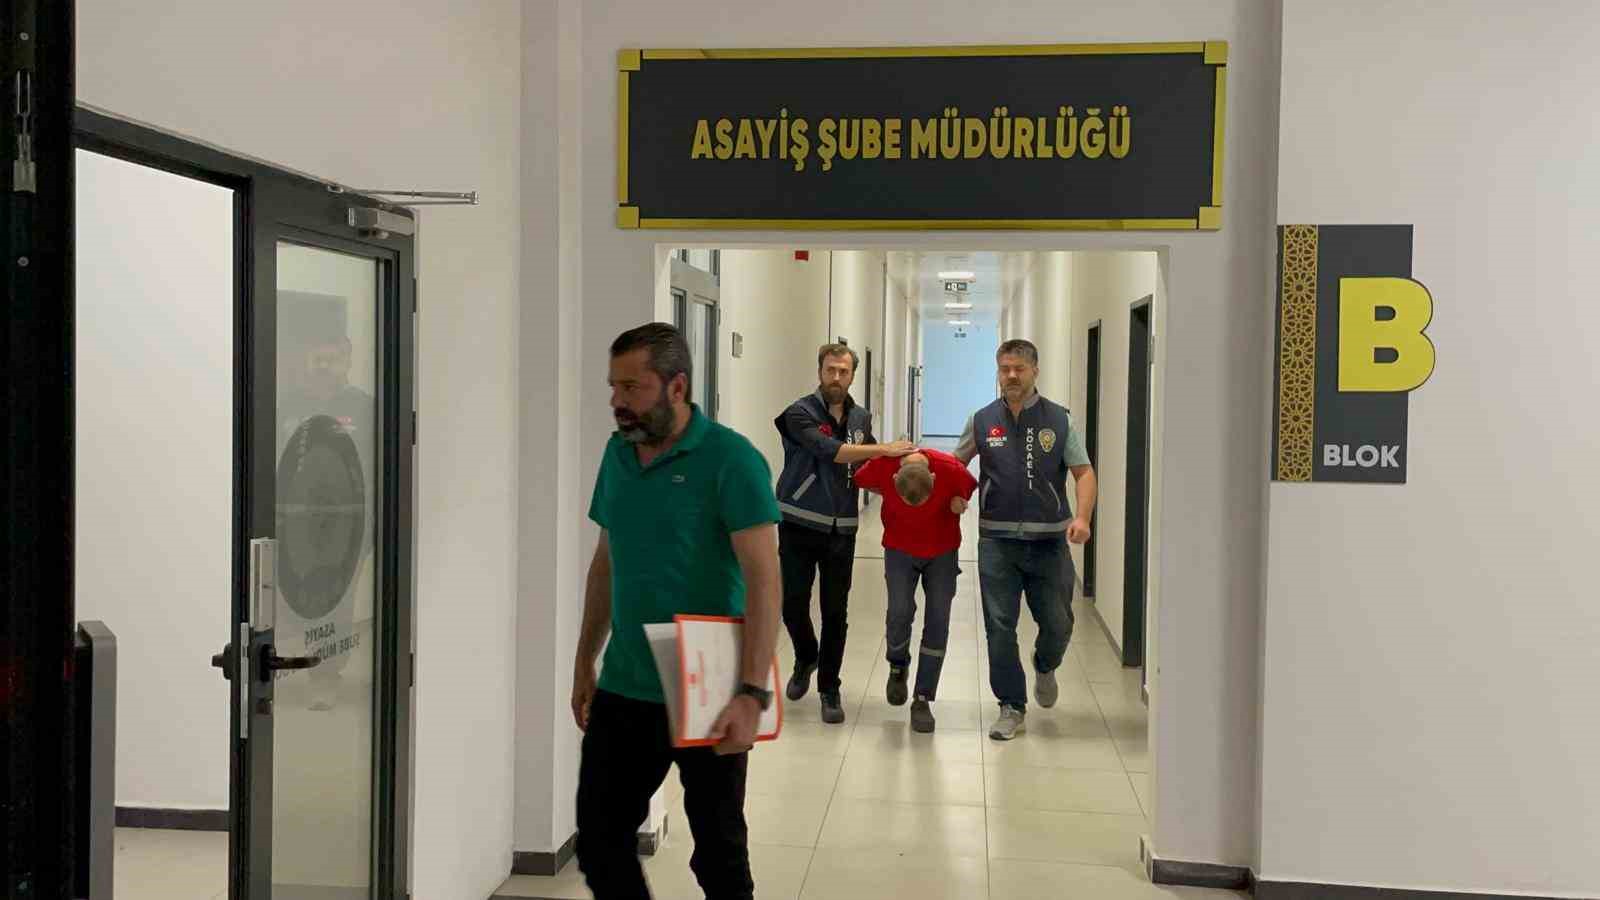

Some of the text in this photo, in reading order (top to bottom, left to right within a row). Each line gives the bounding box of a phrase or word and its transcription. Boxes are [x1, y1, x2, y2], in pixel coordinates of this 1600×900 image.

[691, 106, 1131, 171] ASAYİŞ ŞUBE MÜDÜRLÜĞÜ
[1338, 277, 1436, 392] B
[1323, 444, 1400, 468] BLOK
